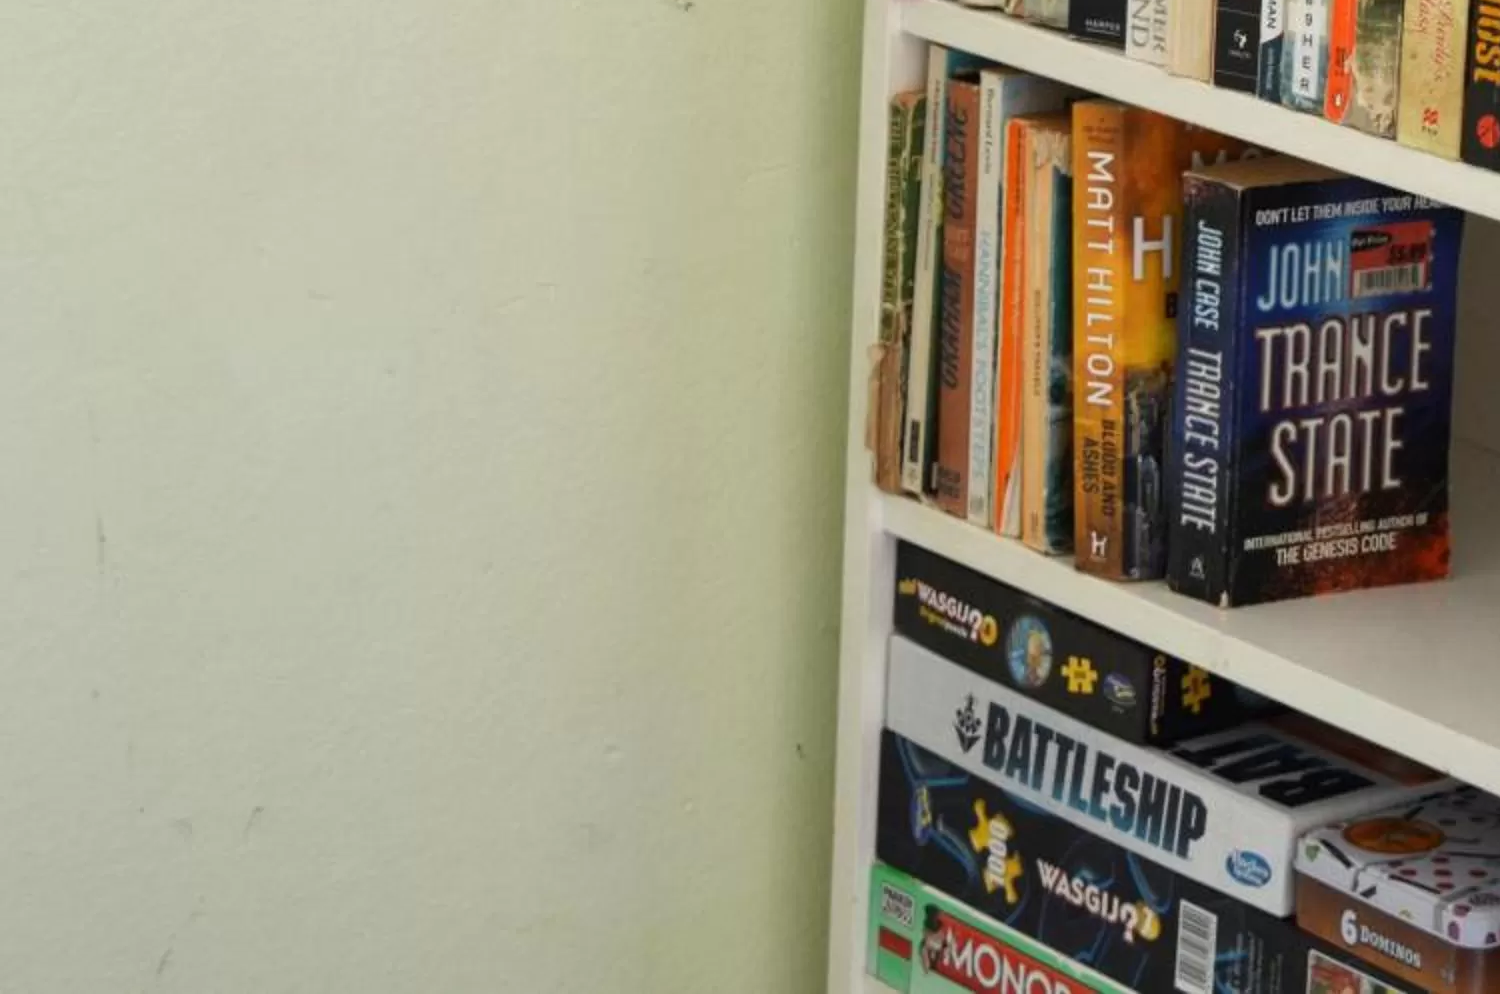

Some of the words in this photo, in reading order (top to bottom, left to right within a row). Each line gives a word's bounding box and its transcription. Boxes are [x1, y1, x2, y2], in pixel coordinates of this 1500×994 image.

[1086, 149, 1116, 264] MATT
[1254, 208, 1289, 227] DON'T
[1290, 206, 1310, 223] LET
[1313, 202, 1343, 220] THEM
[1343, 198, 1380, 217] INSIDE
[1381, 195, 1411, 213] YOUR
[1196, 220, 1224, 279] JOHN
[1257, 239, 1345, 313] JOHN
[1193, 277, 1220, 332] CASE
[1085, 269, 1115, 408] HILTON
[1255, 309, 1433, 414] TRANCE
[1184, 347, 1223, 452] TRANCE
[1082, 435, 1101, 495] ASHES
[1180, 448, 1220, 534] STATE
[1268, 408, 1405, 507] STATE
[1100, 478, 1116, 517] AND
[1243, 528, 1313, 551] INTERNATIONAL
[1377, 514, 1414, 534] AUTHOR
[1414, 512, 1429, 527] OF
[1275, 544, 1301, 566] THE
[1302, 536, 1359, 562] GENESIS
[1361, 533, 1397, 554] CODE
[982, 700, 1209, 861] BATTLESHIP
[1340, 908, 1359, 946] 6
[1360, 924, 1422, 968] DOMINOS
